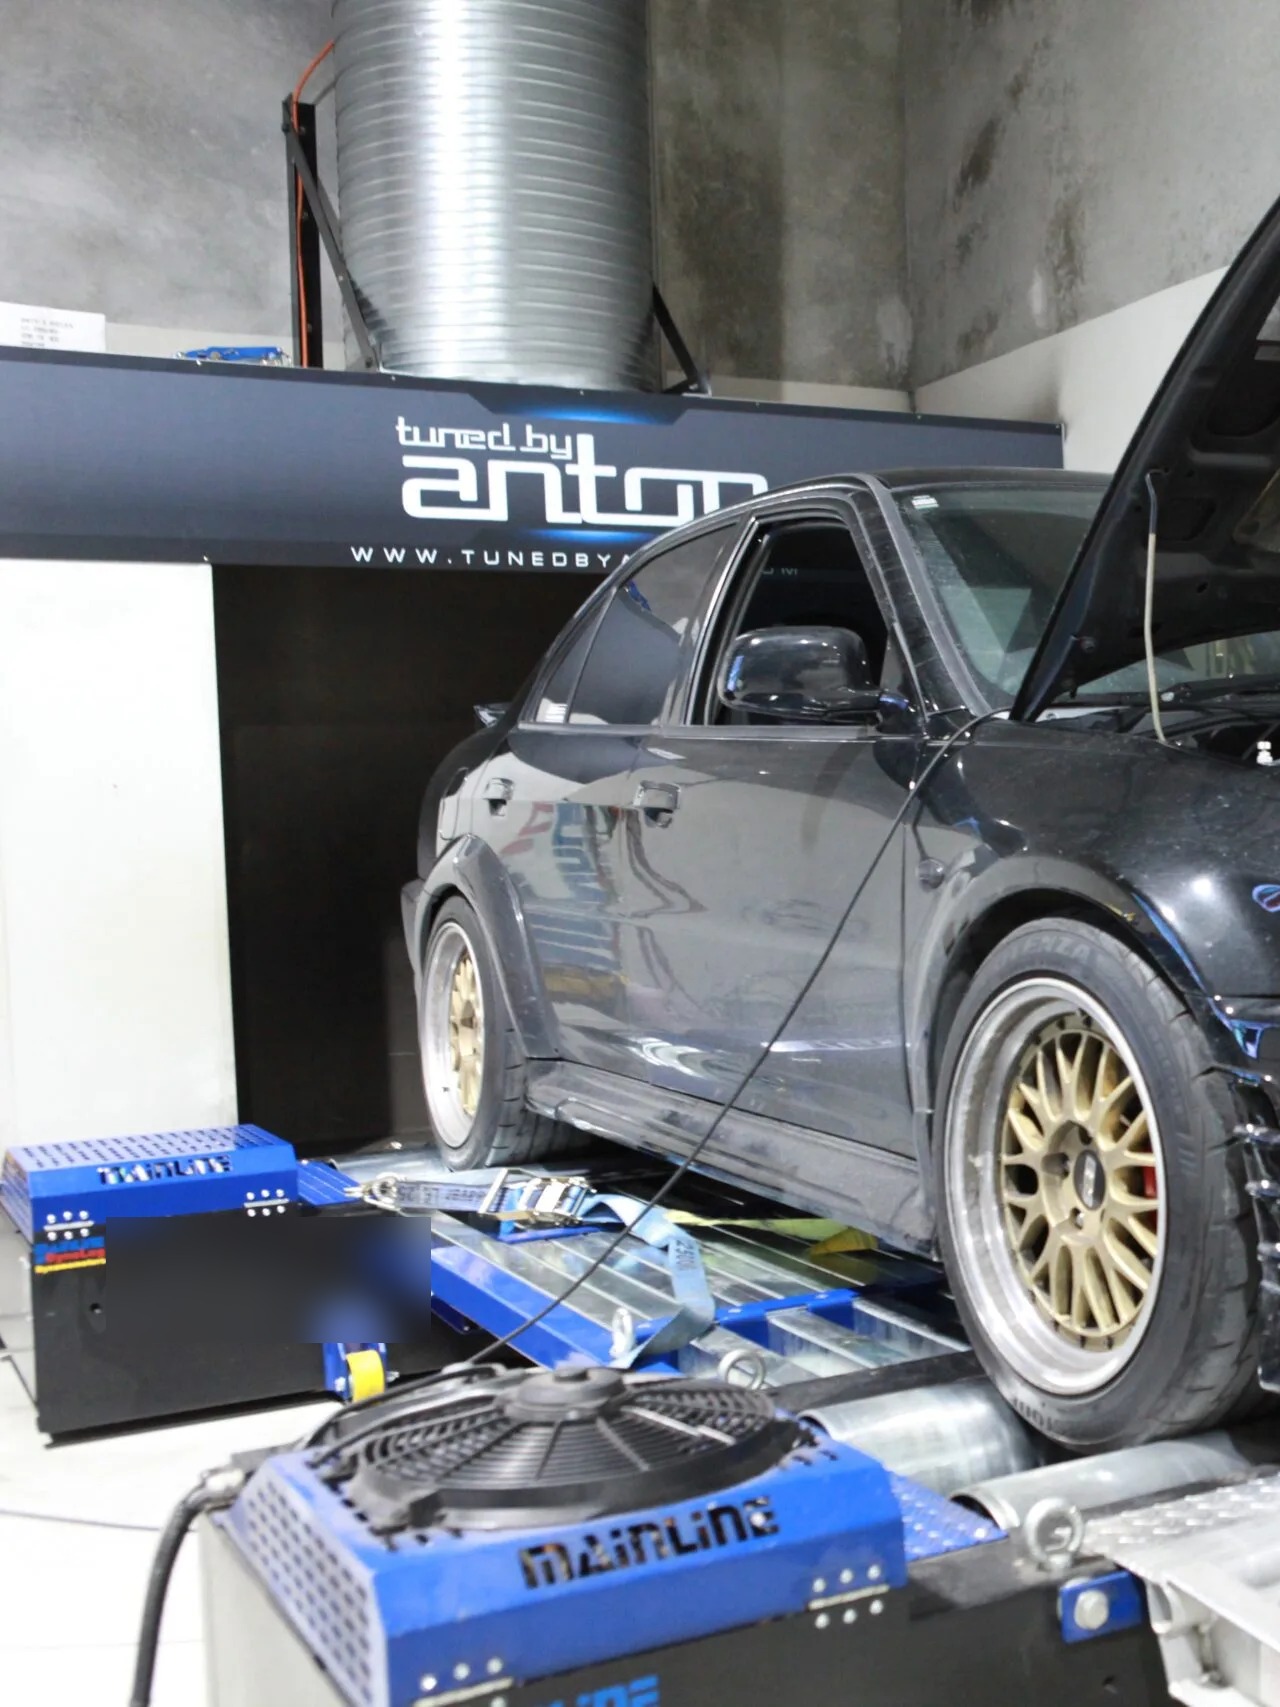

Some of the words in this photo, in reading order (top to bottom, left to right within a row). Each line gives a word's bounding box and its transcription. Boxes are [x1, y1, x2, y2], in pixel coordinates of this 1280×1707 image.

[395, 416, 515, 450] tuned
[520, 424, 572, 460] by
[518, 1496, 779, 1589] MAINLINE
